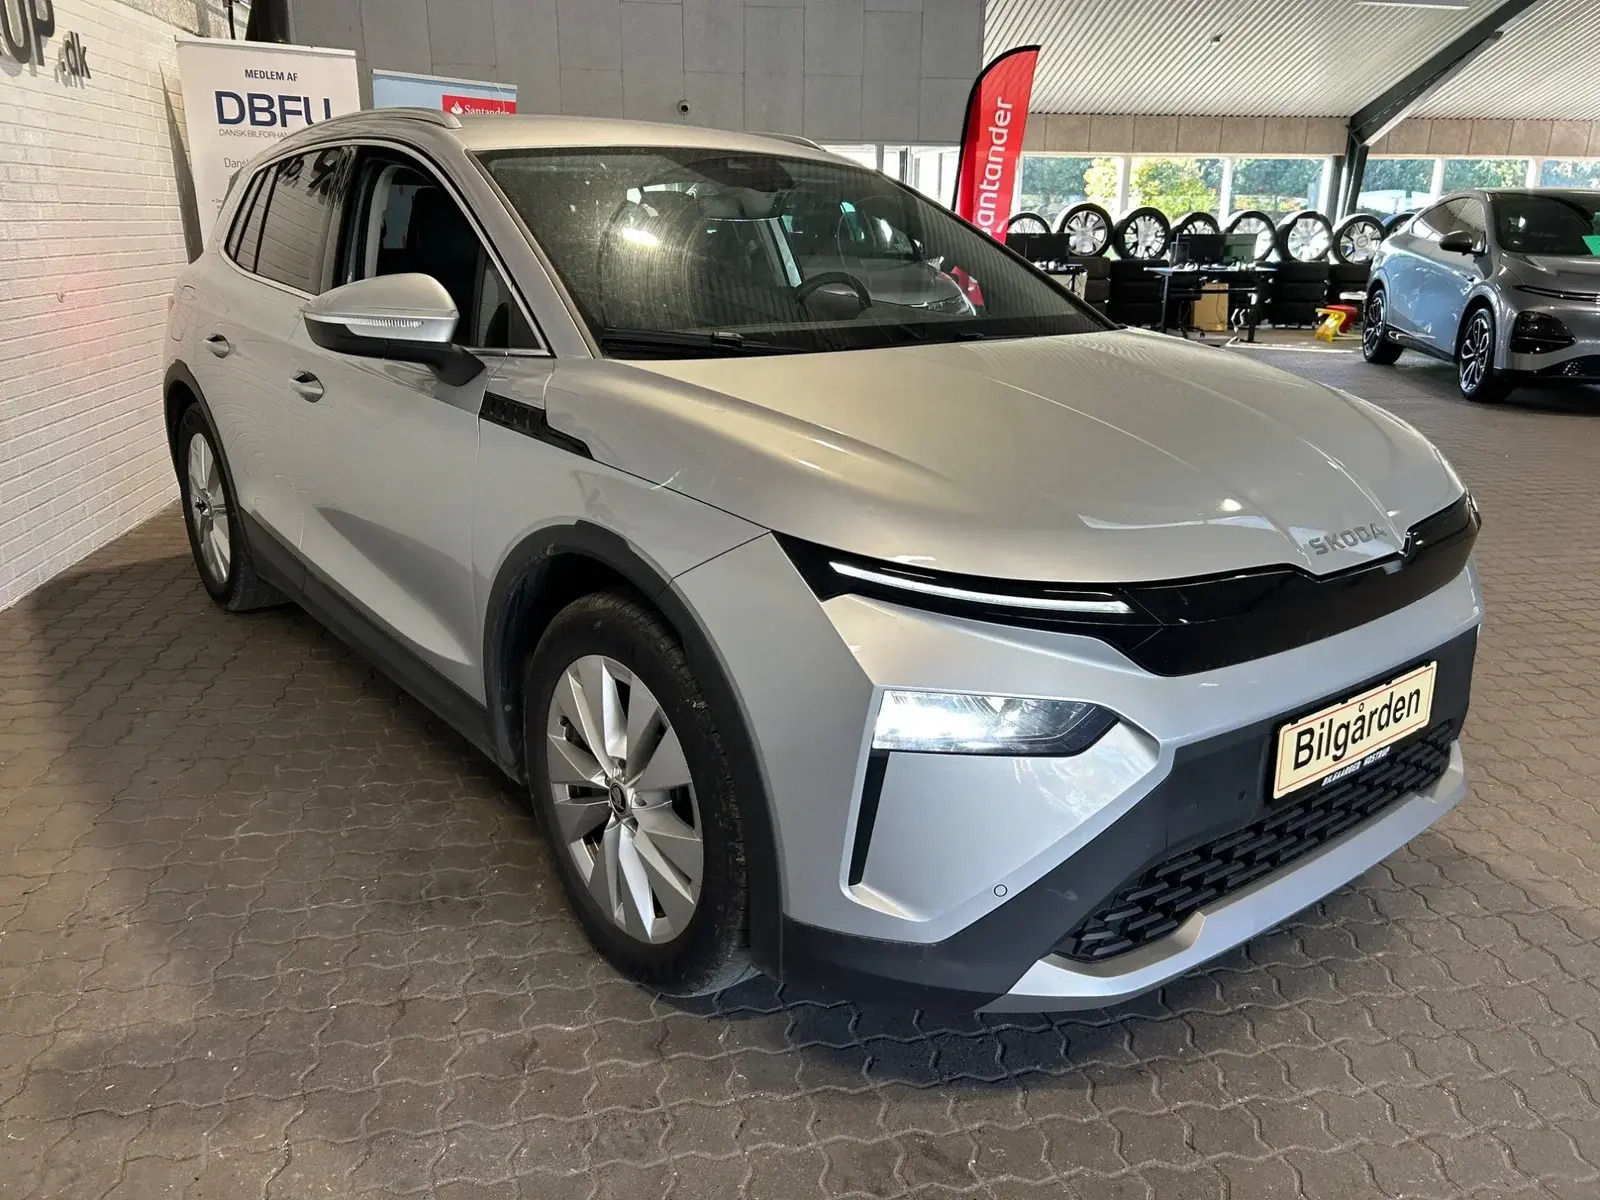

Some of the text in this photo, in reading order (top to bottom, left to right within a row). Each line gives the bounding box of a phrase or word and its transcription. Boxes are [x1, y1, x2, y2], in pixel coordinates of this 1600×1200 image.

[245, 69, 298, 82] MEDLEM AF
[215, 91, 331, 127] DBFU
[1293, 688, 1421, 770] Bilgården
